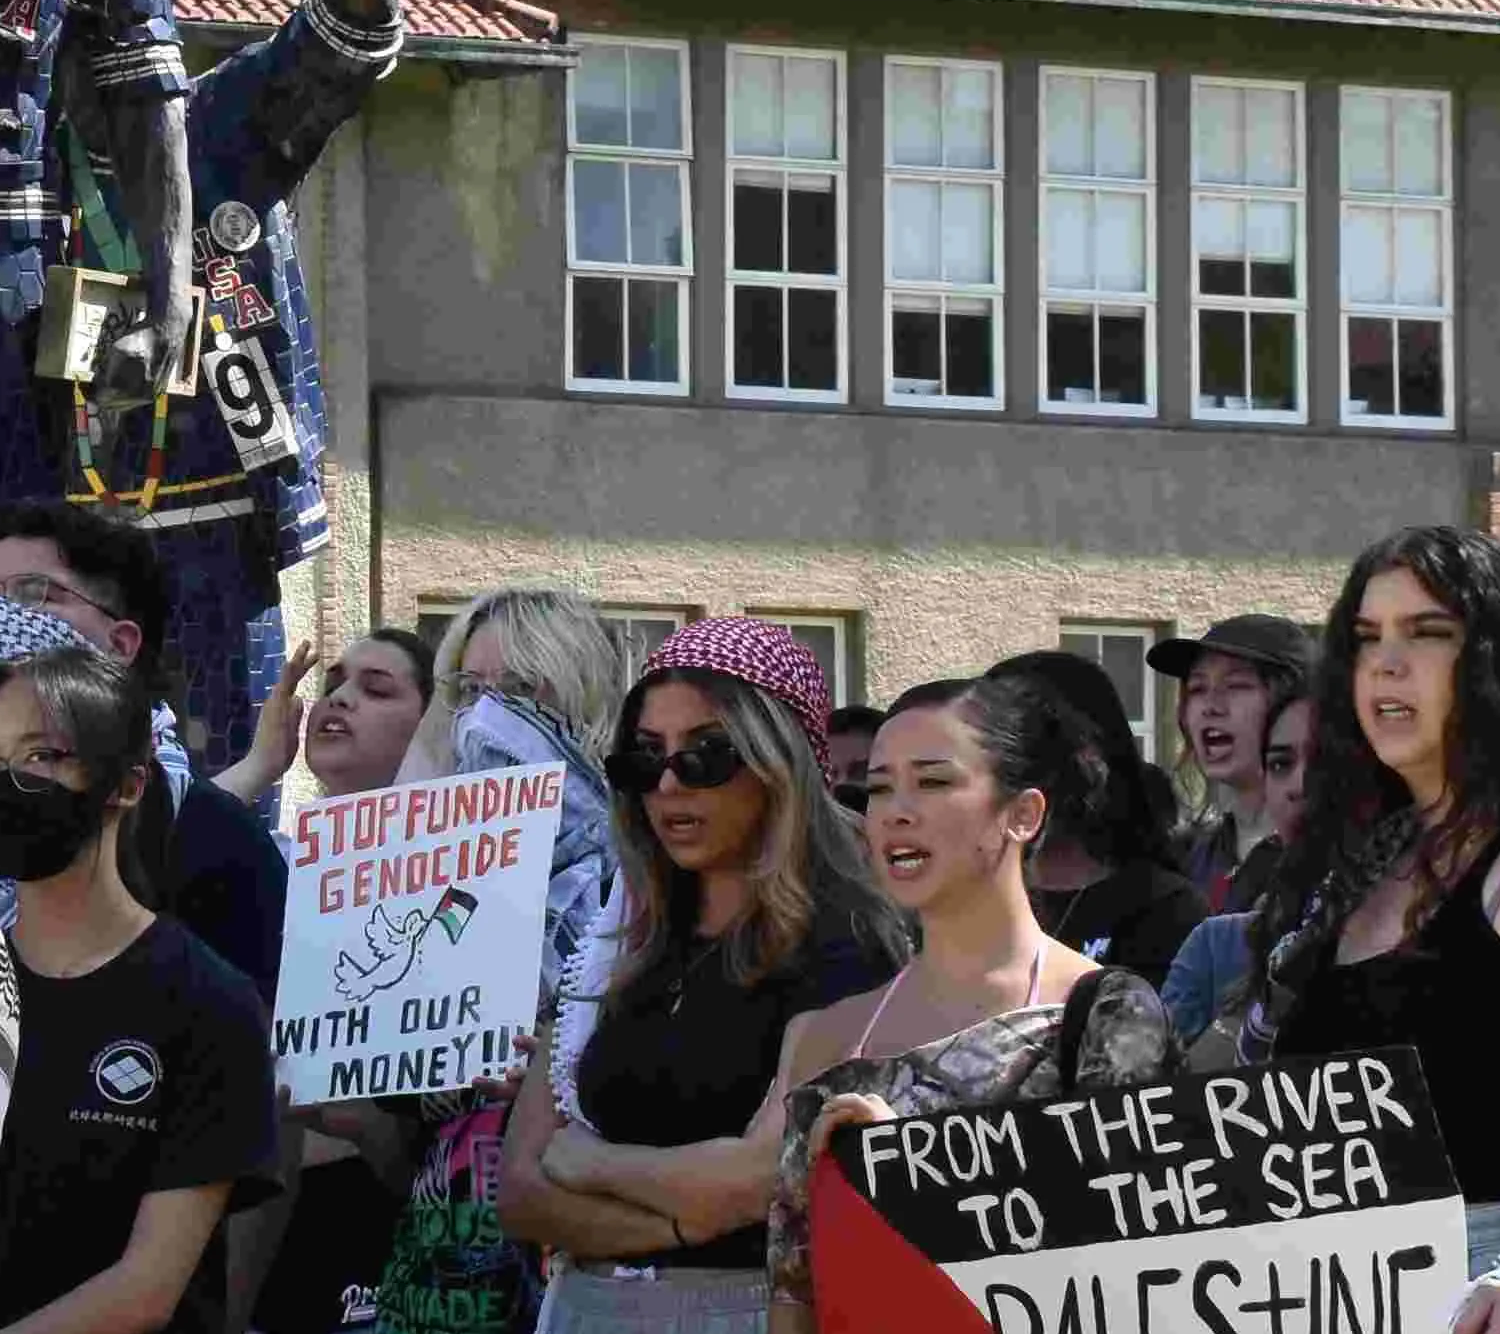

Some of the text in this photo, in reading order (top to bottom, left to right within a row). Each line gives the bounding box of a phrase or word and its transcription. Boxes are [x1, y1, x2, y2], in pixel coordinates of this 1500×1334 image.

[295, 770, 562, 868] STOP FUNDING
[319, 827, 522, 915] GENOCIDE
[274, 985, 482, 1057] WITH OUR
[862, 1057, 1415, 1197] FROM THE RIVER
[958, 1137, 1390, 1252] TO THE SEA
